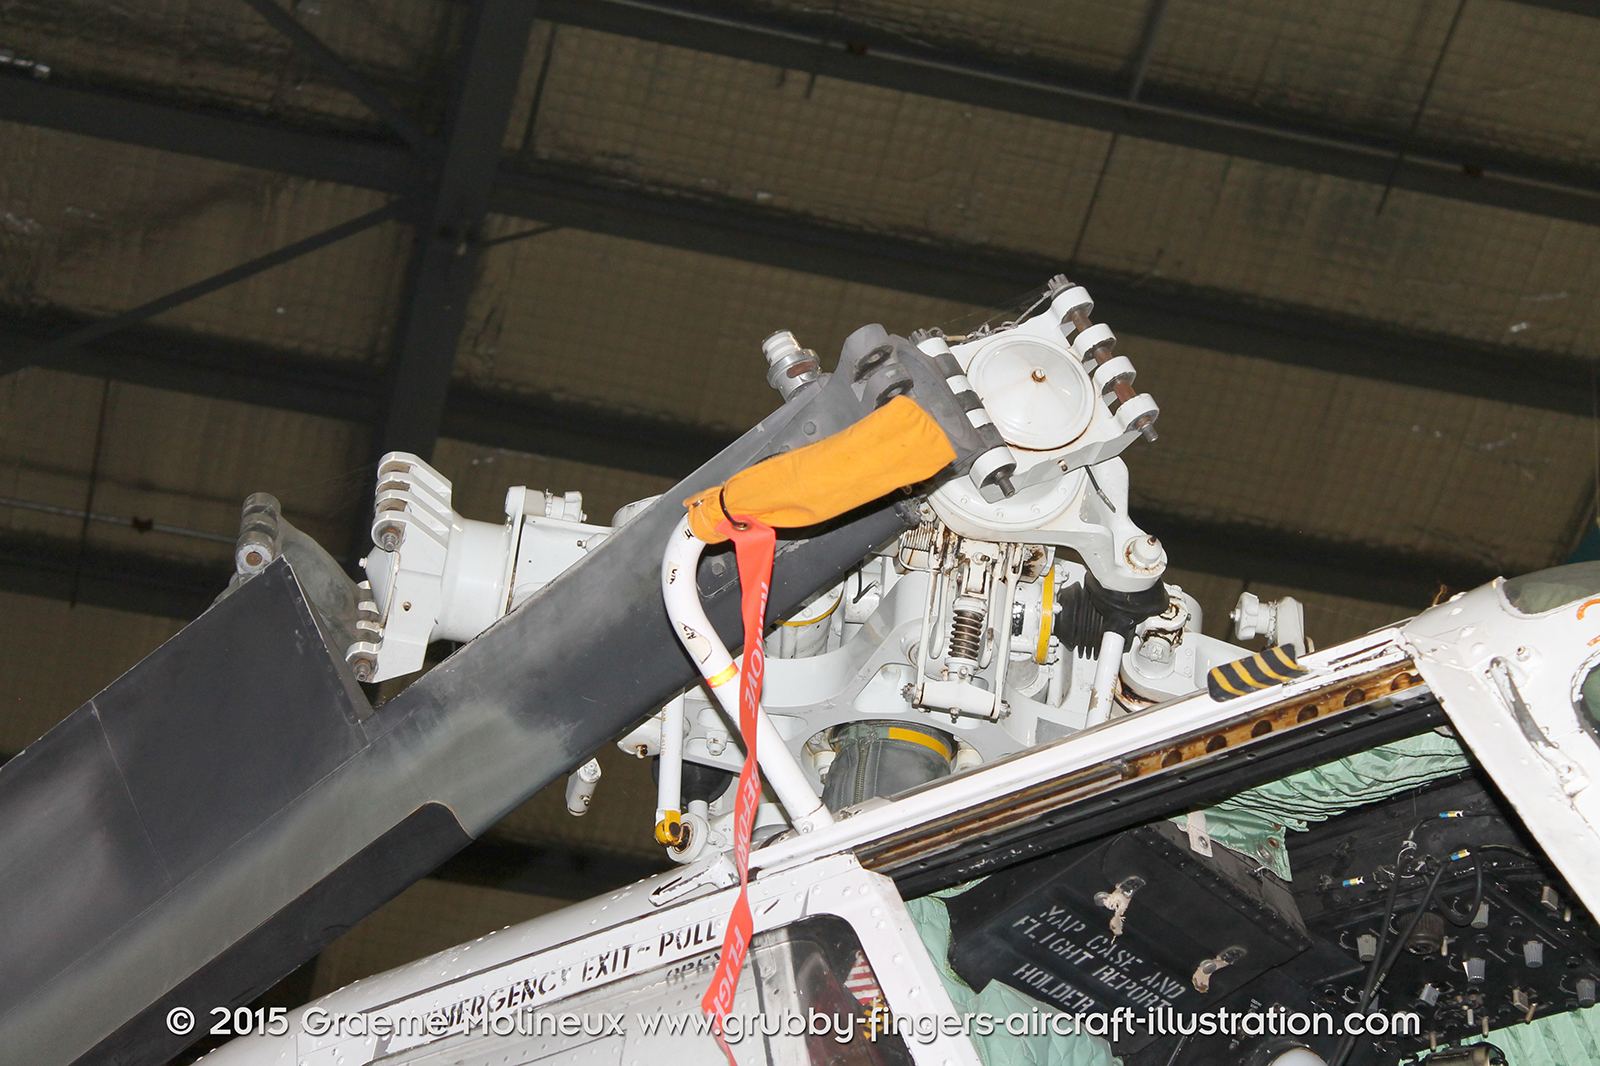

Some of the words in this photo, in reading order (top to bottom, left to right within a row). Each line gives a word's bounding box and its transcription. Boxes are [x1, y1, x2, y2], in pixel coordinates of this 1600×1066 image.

[582, 944, 632, 983] EXIT
[659, 920, 717, 957] PULL
[706, 925, 745, 1029] FLIGH
[1012, 915, 1094, 965] FLIGHT
[1092, 964, 1173, 1013] REPORT
[1012, 962, 1095, 1013] HOLDER
[1039, 905, 1086, 932] MAP
[1085, 935, 1143, 971] CASE
[1140, 971, 1187, 999] AND
